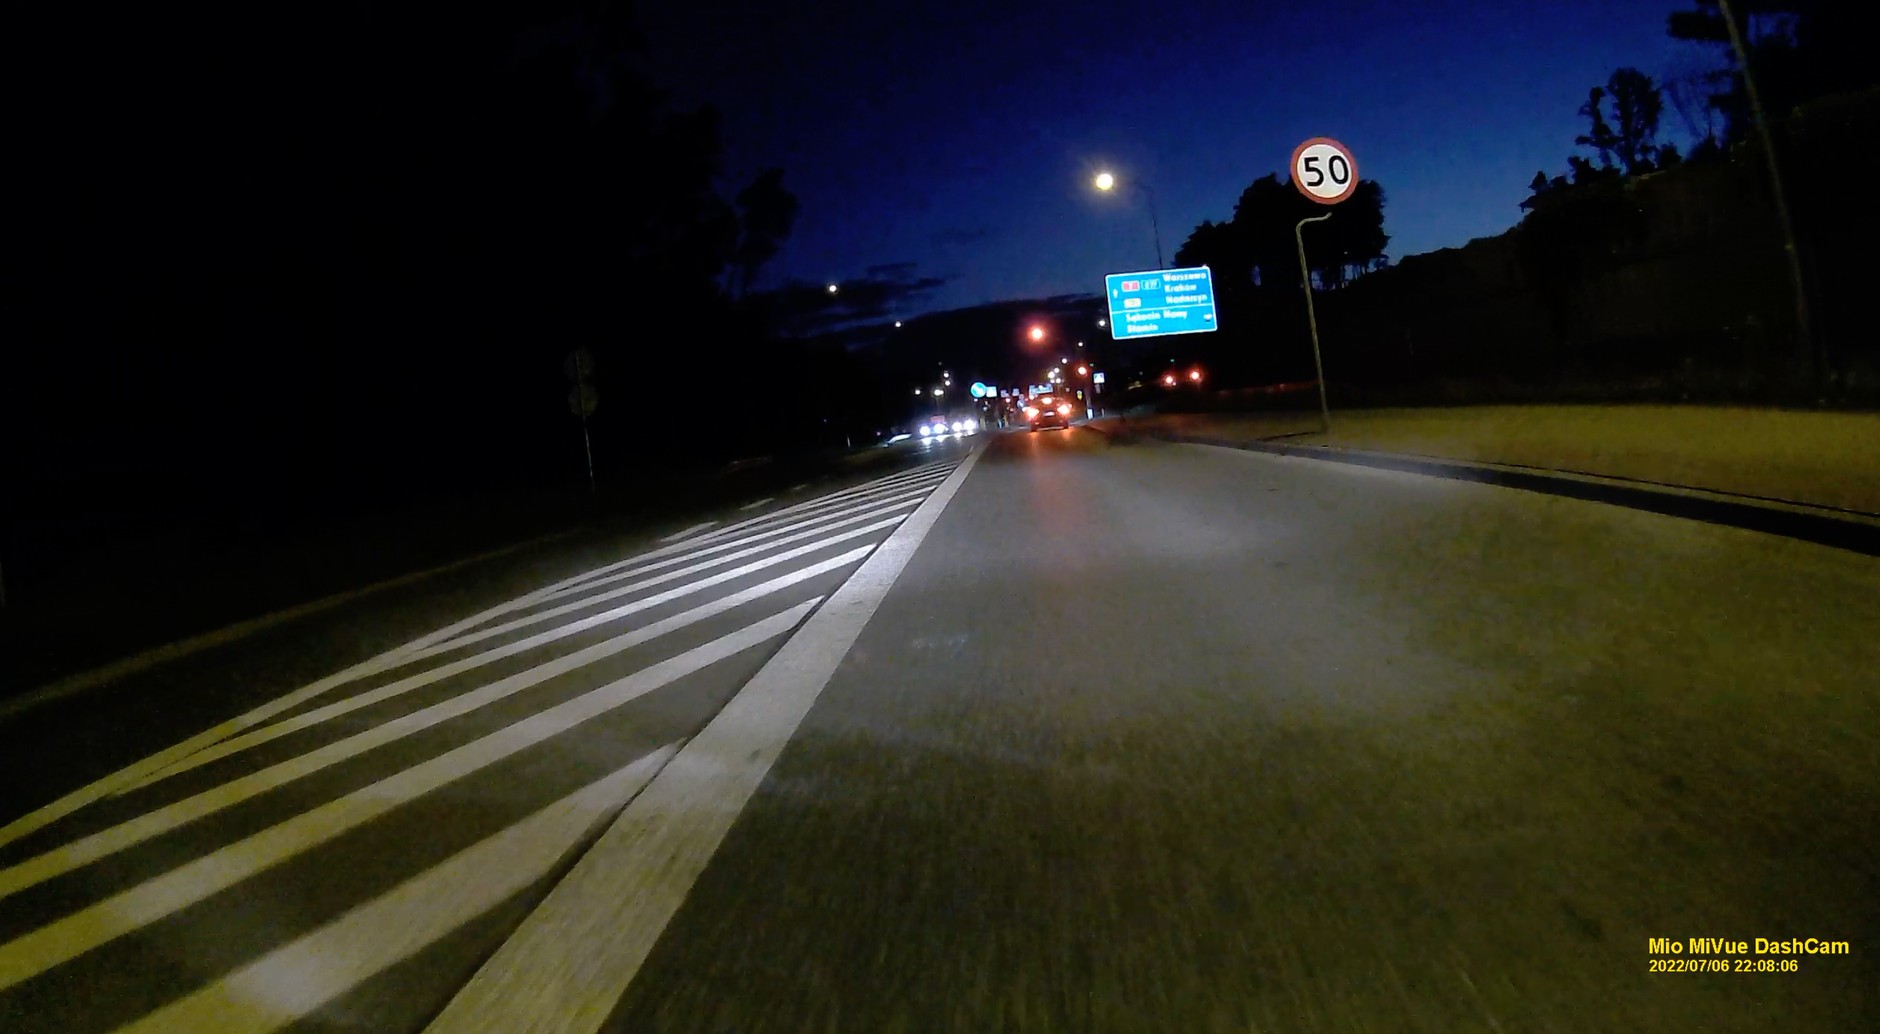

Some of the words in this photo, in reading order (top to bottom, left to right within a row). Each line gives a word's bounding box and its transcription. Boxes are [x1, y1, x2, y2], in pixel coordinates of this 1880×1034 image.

[1304, 155, 1349, 187] 50
[1162, 273, 1207, 282] Warszawa
[1164, 284, 1197, 293] Kraków
[1165, 294, 1208, 304] Nadarzyn
